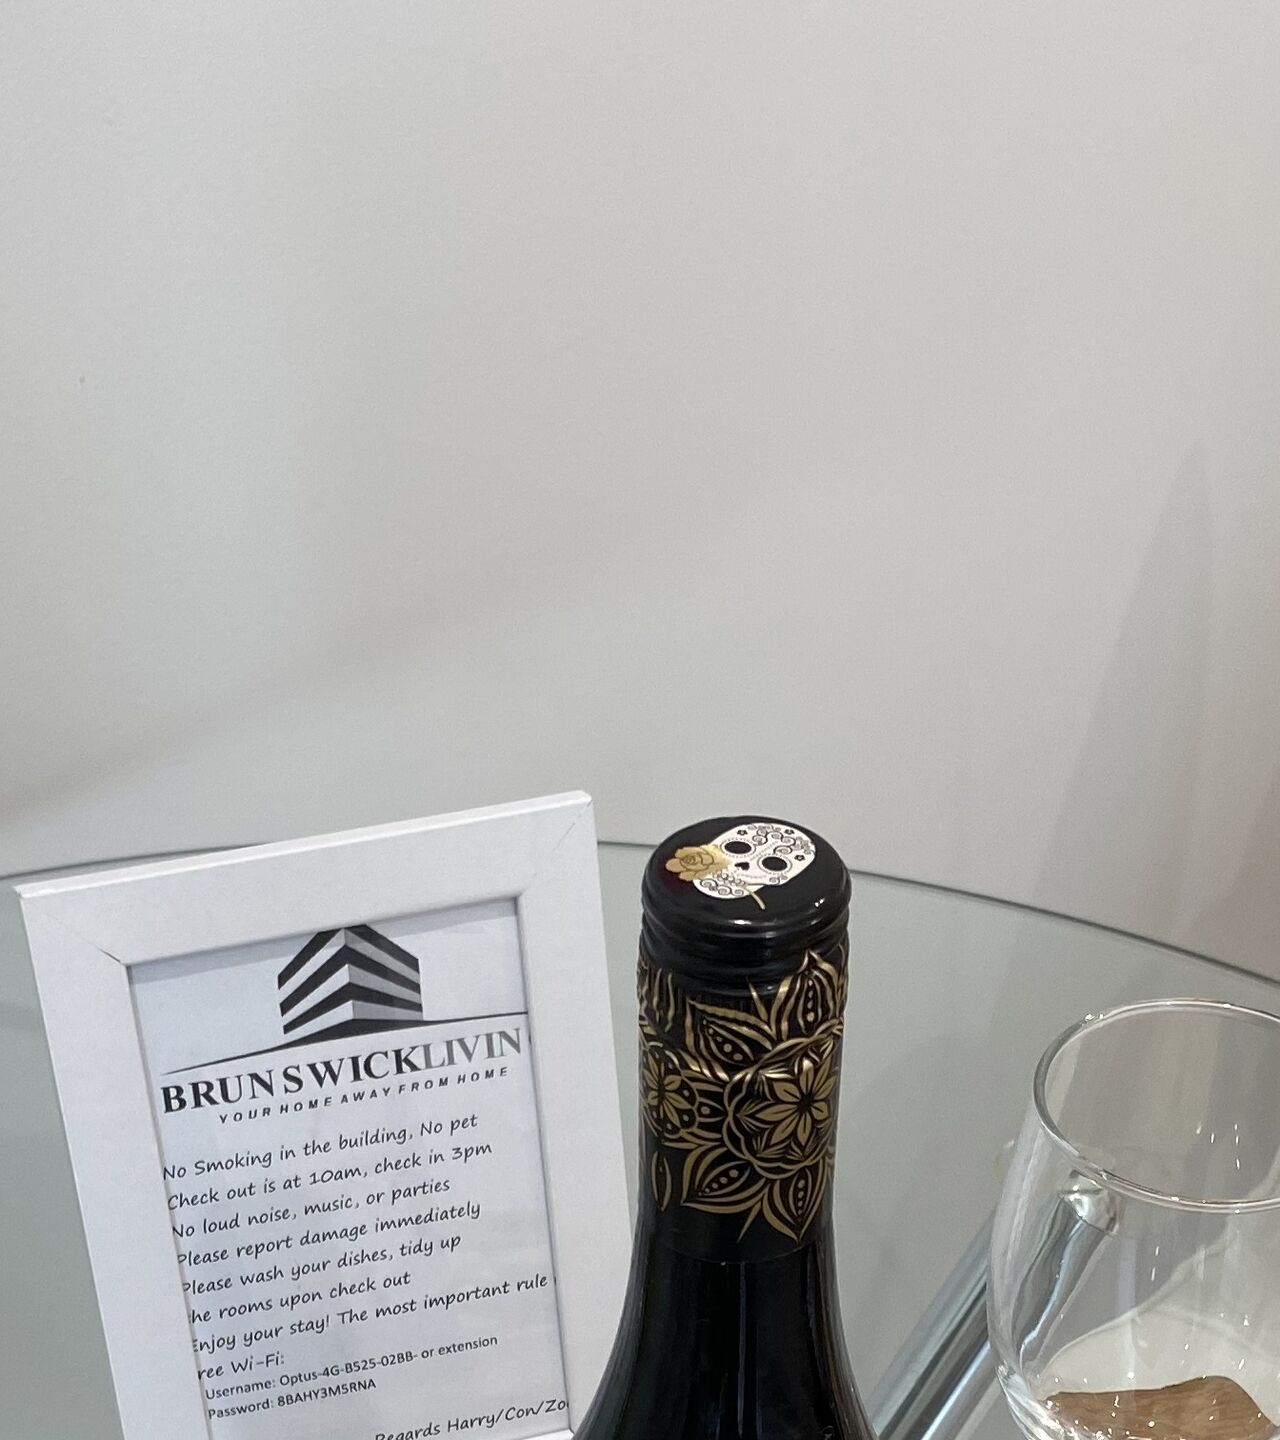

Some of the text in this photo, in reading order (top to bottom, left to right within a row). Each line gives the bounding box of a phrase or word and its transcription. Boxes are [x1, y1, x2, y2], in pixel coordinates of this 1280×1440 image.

[160, 1028, 532, 1114] BRUNSWICKLIVIN
[220, 1066, 508, 1124] YOUR HOME AWAY FROM HOME
[163, 1114, 478, 1181] No Smoking in the building, No pet
[168, 1143, 493, 1210] Check out is at 10am, check in 3pm
[173, 1178, 450, 1238] No loud noise, music, or parties
[178, 1201, 481, 1267] Please report damage immediately
[182, 1235, 461, 1295] Please wash your dishes, tidy up
[188, 1271, 411, 1324] he rooms upon check out
[243, 1324, 284, 1347] your
[290, 1314, 330, 1335] stay!
[337, 1308, 368, 1325] The
[376, 1299, 417, 1319] most
[424, 1281, 510, 1310] important
[517, 1273, 548, 1292] rule
[197, 1351, 285, 1382] ree Wi-Fi:
[205, 1378, 276, 1400] Username:
[421, 1348, 435, 1360] or
[438, 1336, 498, 1356] extension
[208, 1398, 274, 1420] Password:
[447, 1398, 570, 1432] Harry/Con/Zo
